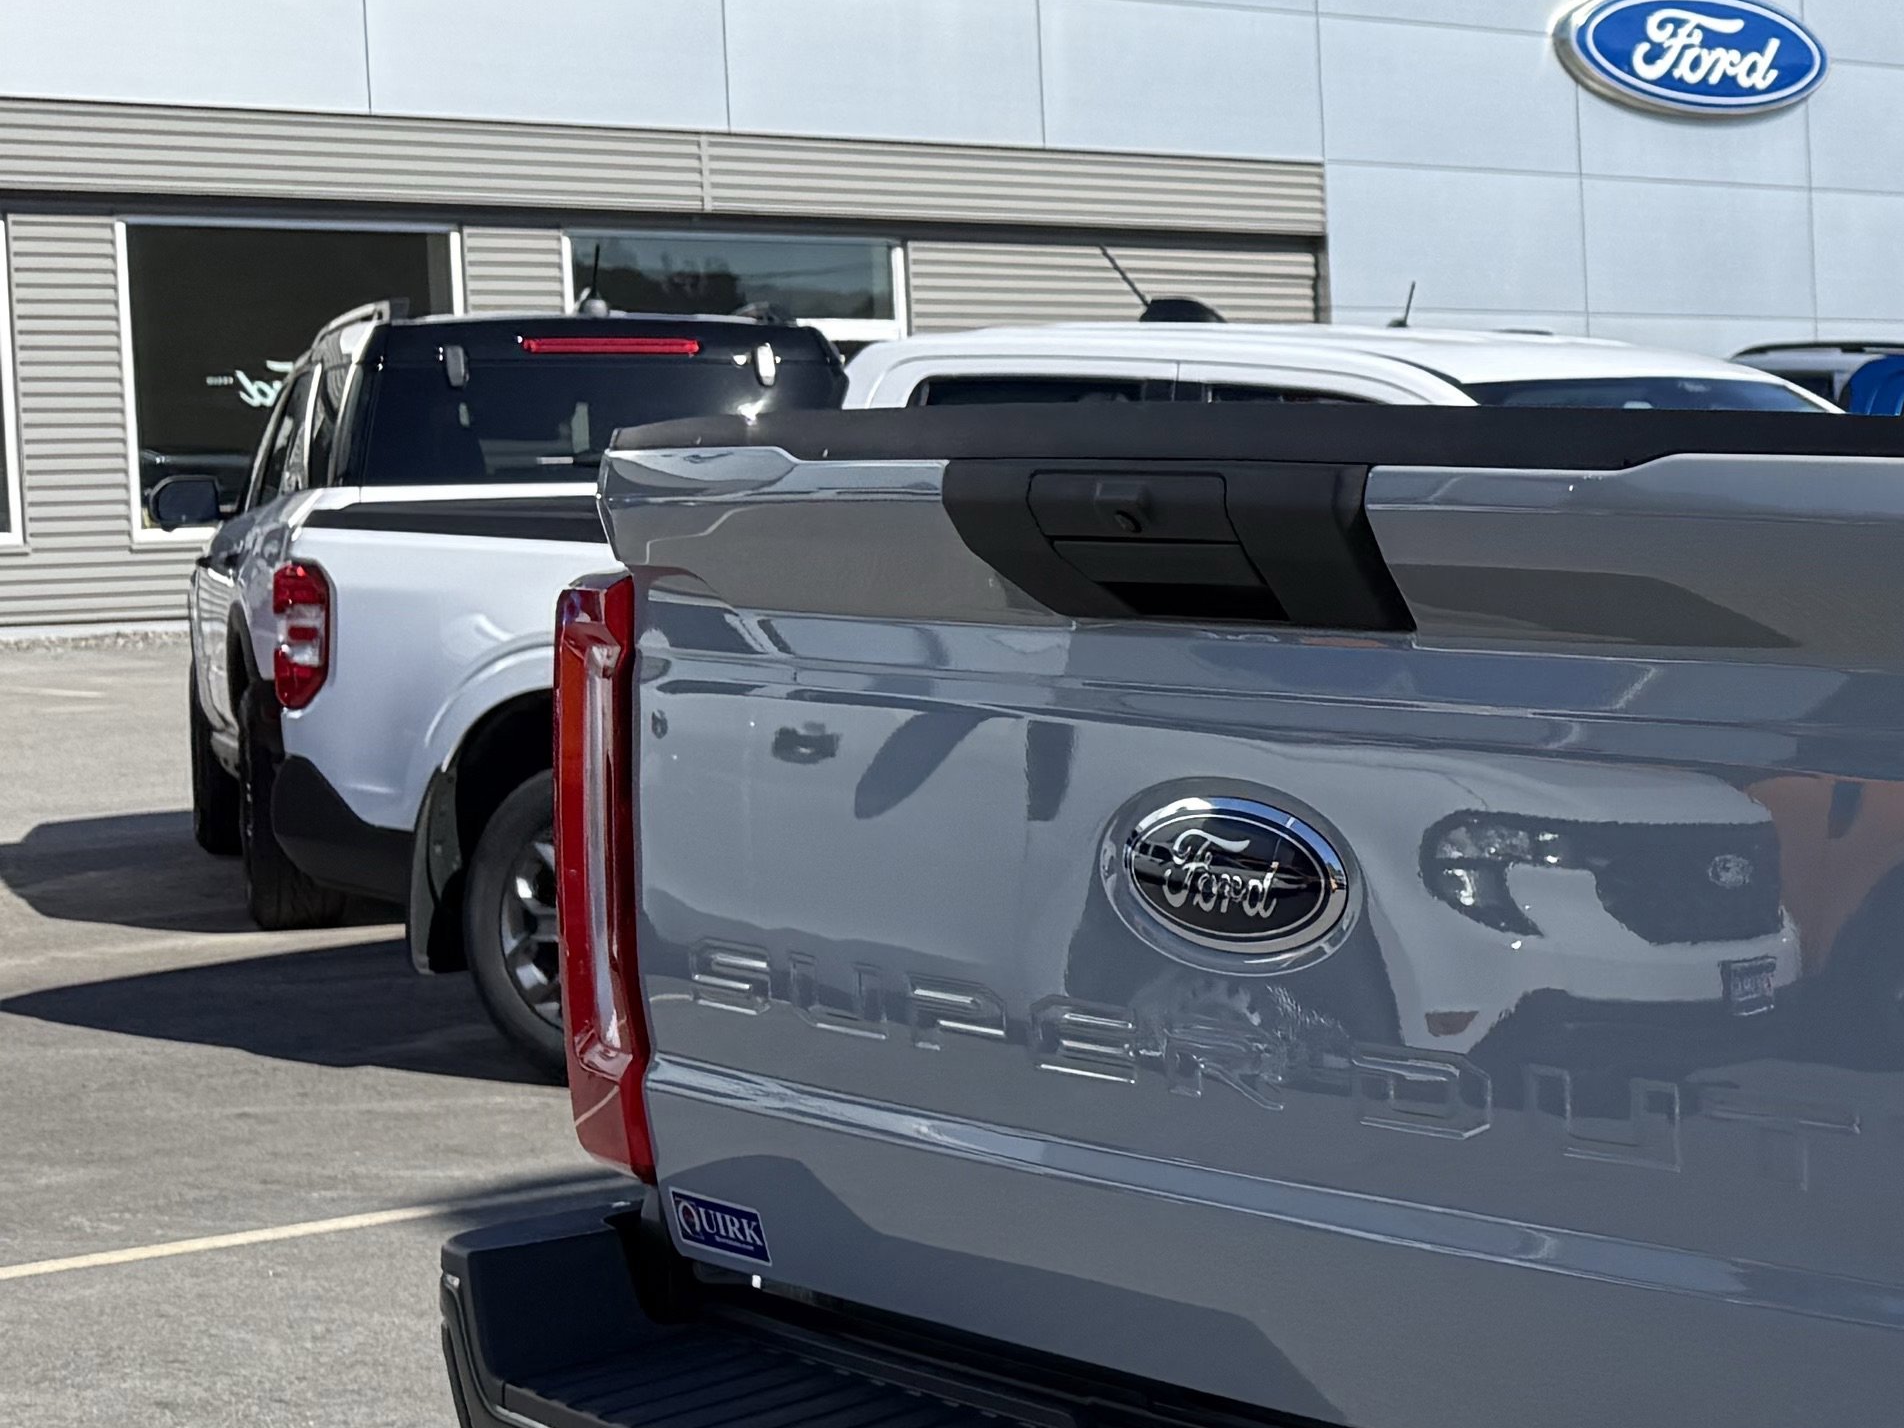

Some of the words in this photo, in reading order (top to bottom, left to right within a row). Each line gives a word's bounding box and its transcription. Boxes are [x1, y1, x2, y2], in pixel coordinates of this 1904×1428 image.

[1632, 8, 1781, 90] Ford
[1162, 828, 1278, 918] Ford
[678, 1198, 763, 1247] QUIRK
